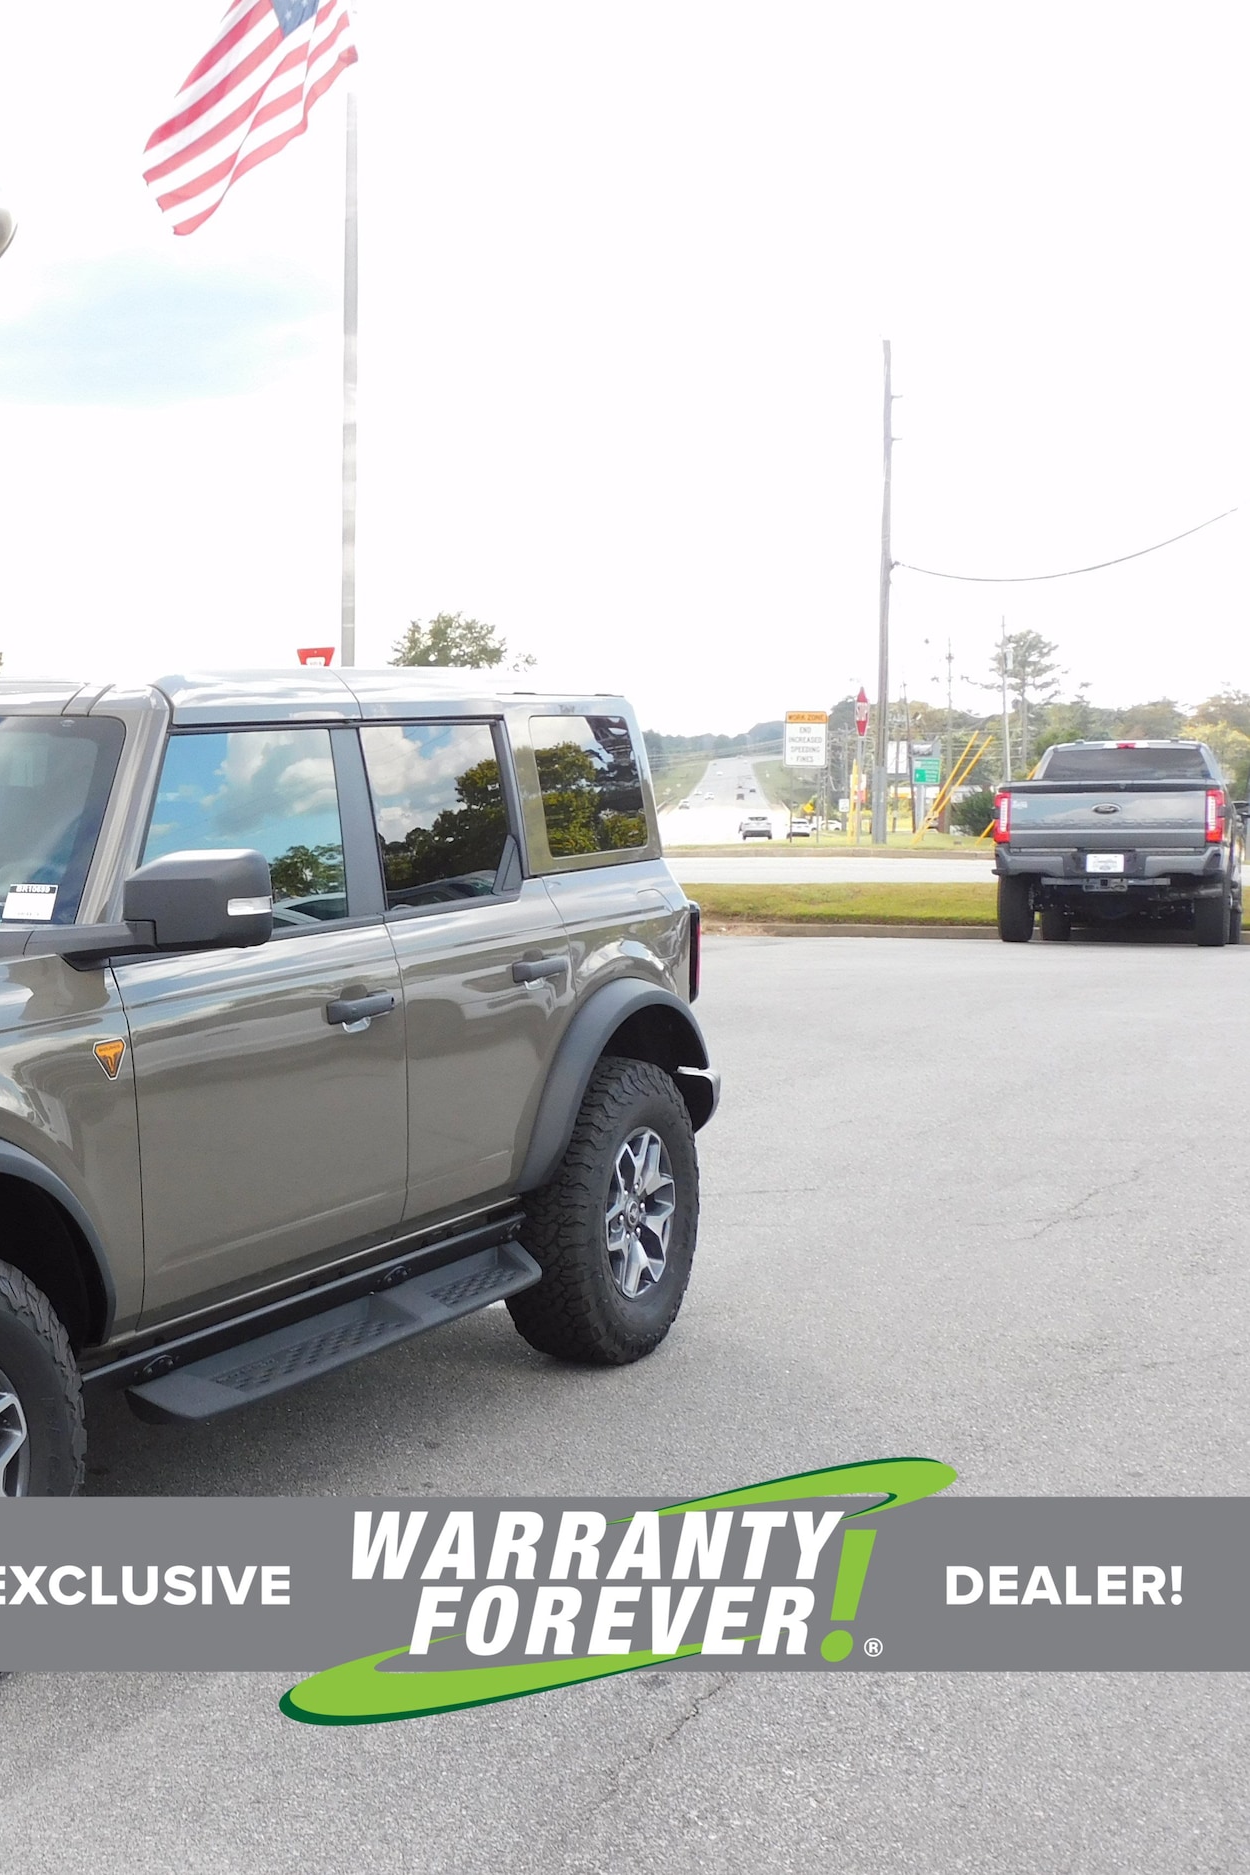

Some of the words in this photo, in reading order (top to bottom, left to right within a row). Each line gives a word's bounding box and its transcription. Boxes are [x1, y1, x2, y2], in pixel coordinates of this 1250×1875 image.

[799, 726, 812, 734] END
[788, 736, 823, 744] INCREASED
[796, 755, 814, 763] FINES
